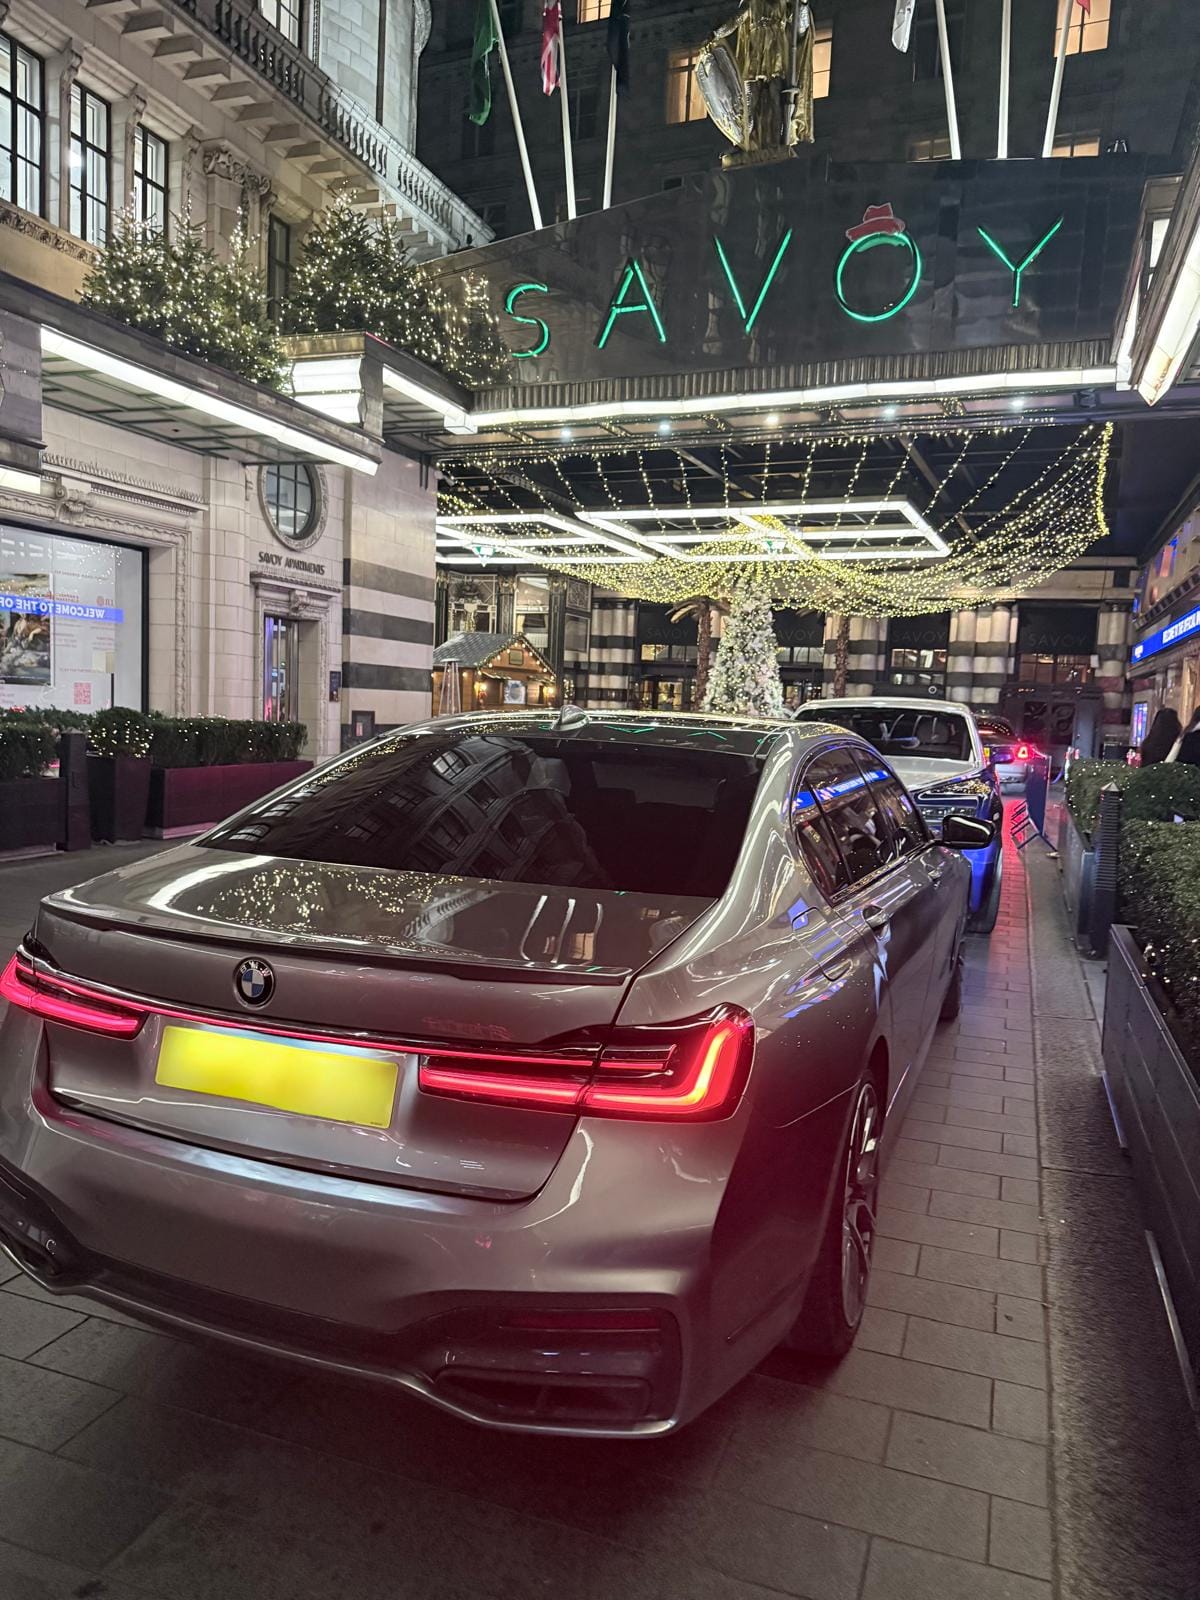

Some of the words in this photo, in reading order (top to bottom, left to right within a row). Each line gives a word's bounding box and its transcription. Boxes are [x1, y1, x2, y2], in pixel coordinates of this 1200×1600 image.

[506, 216, 1064, 359] SAVOY
[259, 551, 283, 566] SAVOY
[285, 557, 325, 575] APARTMENTS
[646, 627, 689, 640] SAVOY
[893, 630, 946, 644] SAVOY
[1029, 632, 1087, 648] SAVOY
[240, 960, 271, 977] BMW
